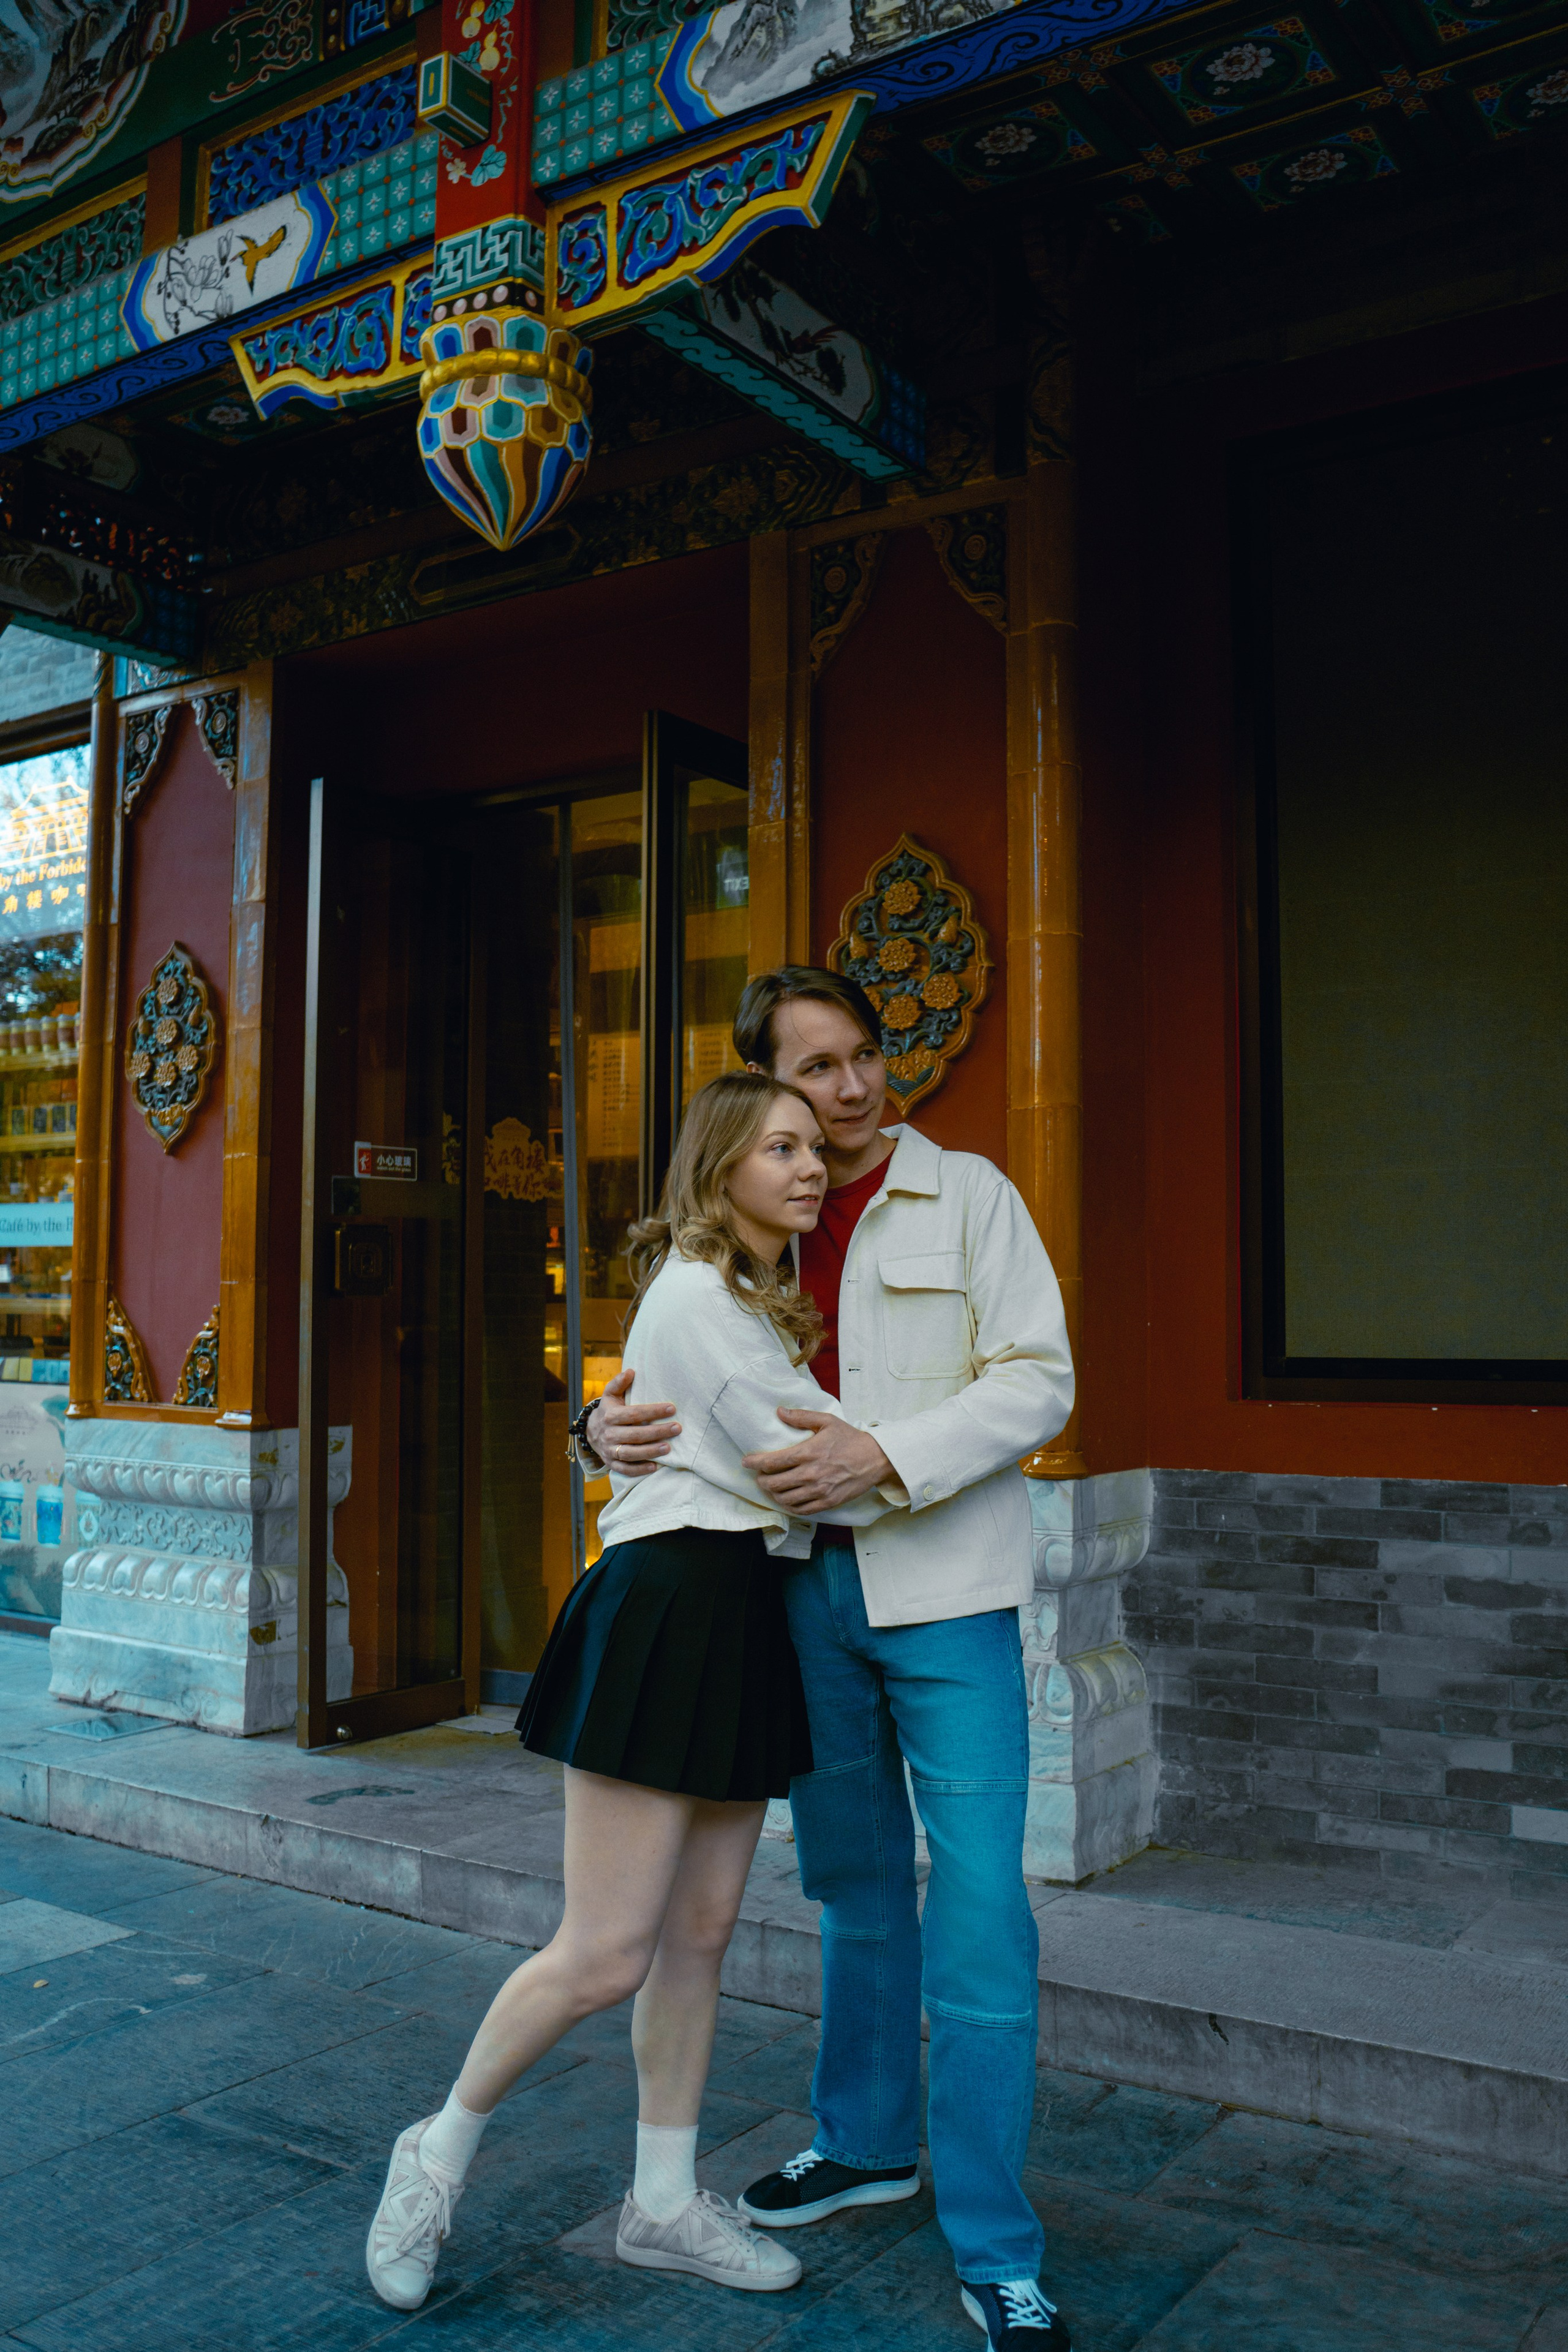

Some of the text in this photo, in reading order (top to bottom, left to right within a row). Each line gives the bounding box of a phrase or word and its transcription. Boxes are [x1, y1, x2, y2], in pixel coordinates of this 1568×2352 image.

[16, 869, 36, 886] the
[377, 1154, 412, 1167] 小心玻璃
[27, 1217, 40, 1236] by
[43, 1216, 61, 1232] the
